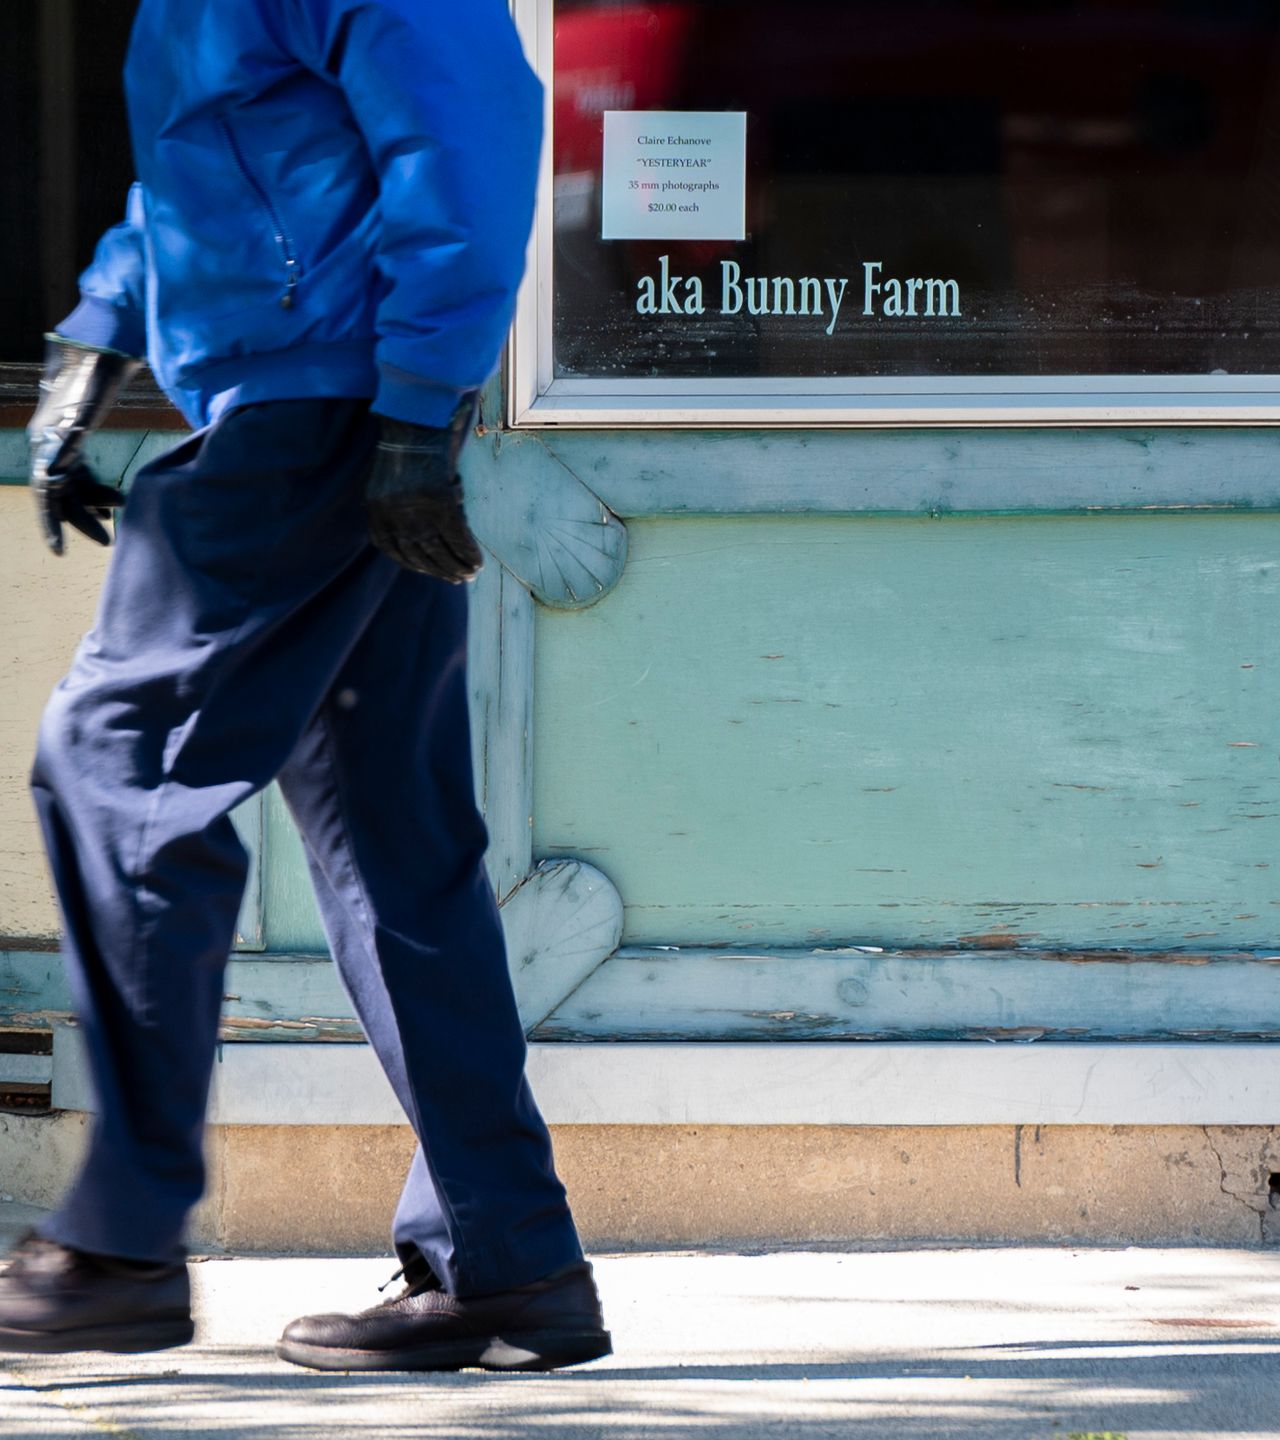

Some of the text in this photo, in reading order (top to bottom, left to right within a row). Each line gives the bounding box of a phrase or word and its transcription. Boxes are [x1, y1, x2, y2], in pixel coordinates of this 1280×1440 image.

[637, 135, 712, 146] Claire Echanove
[628, 180, 719, 192] 35 mm photographs
[648, 202, 699, 213] $20.00 each
[636, 254, 962, 335] aka Bunny Farm
